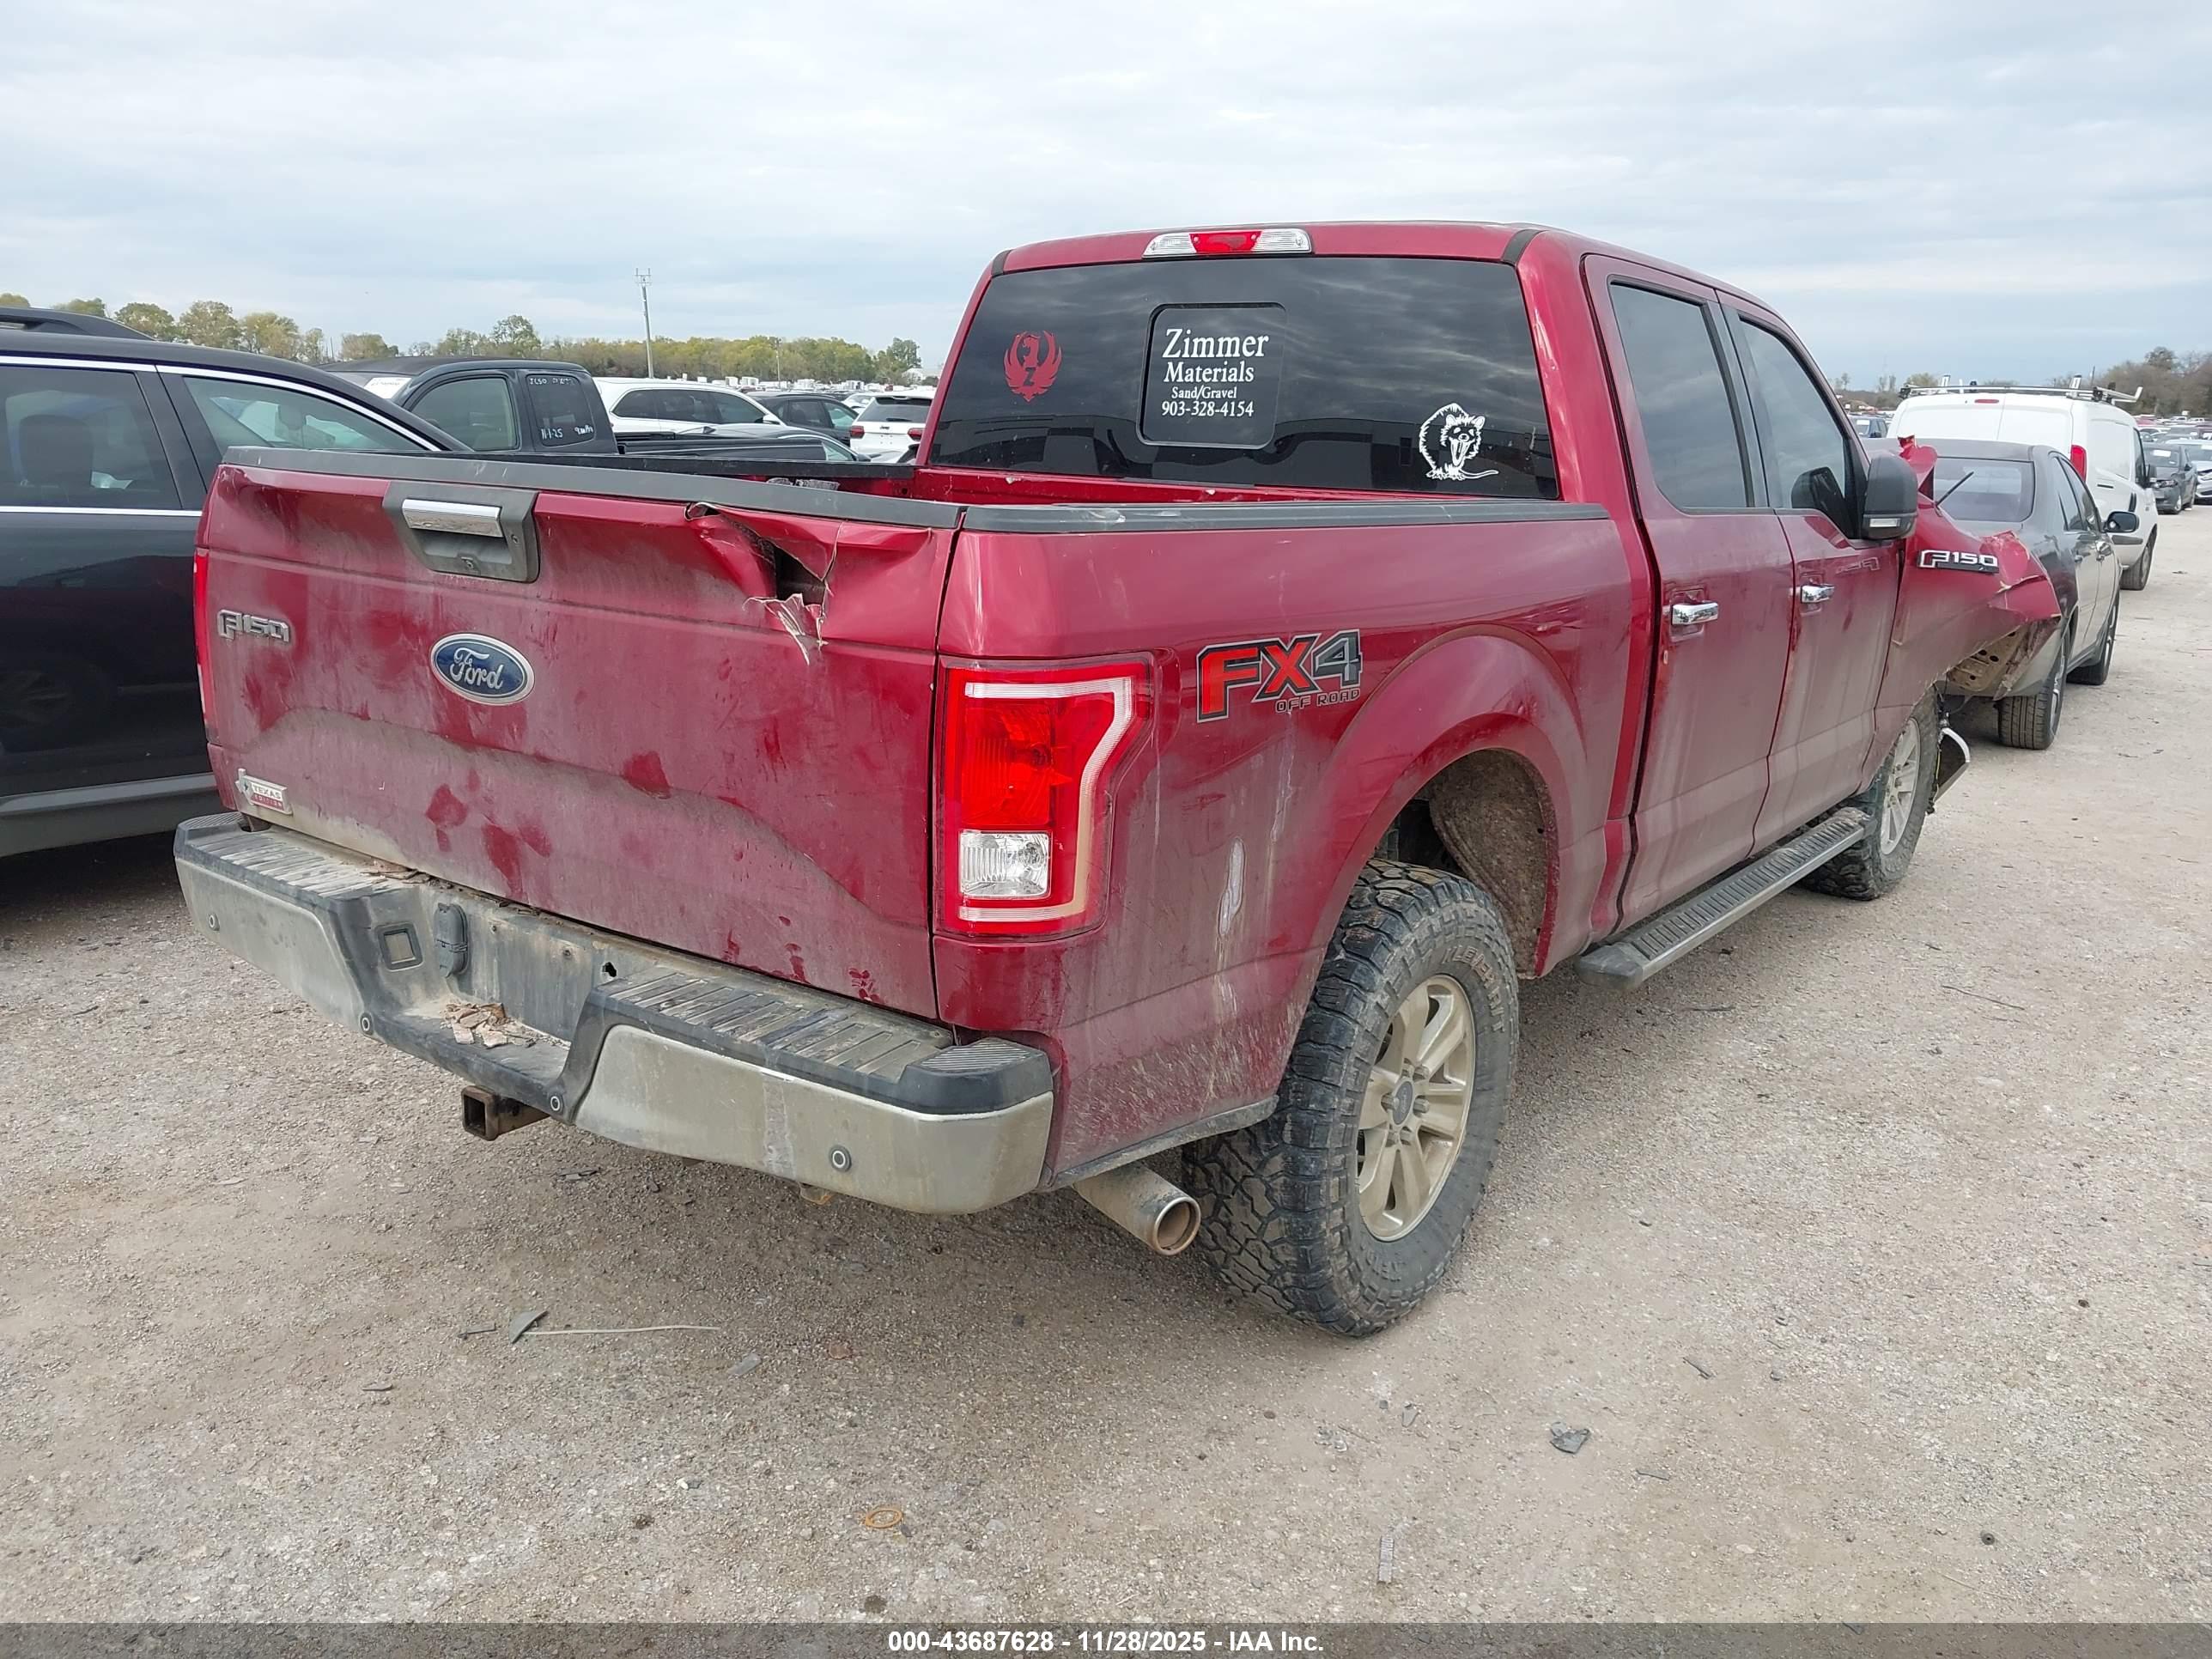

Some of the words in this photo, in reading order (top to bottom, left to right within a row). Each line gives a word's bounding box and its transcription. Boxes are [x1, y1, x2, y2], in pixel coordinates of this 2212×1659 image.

[1162, 328, 1270, 358] Zimmer
[1163, 361, 1255, 383] Materials
[1171, 385, 1237, 400] Sand/Gravel
[1162, 400, 1255, 417] 903-328-4154
[1919, 549, 1999, 568] F150
[449, 647, 504, 690] Ford
[1196, 629, 1363, 723] FX4
[1274, 696, 1311, 714] OFF
[1316, 688, 1361, 707] ROAD
[252, 785, 282, 799] TEXAS
